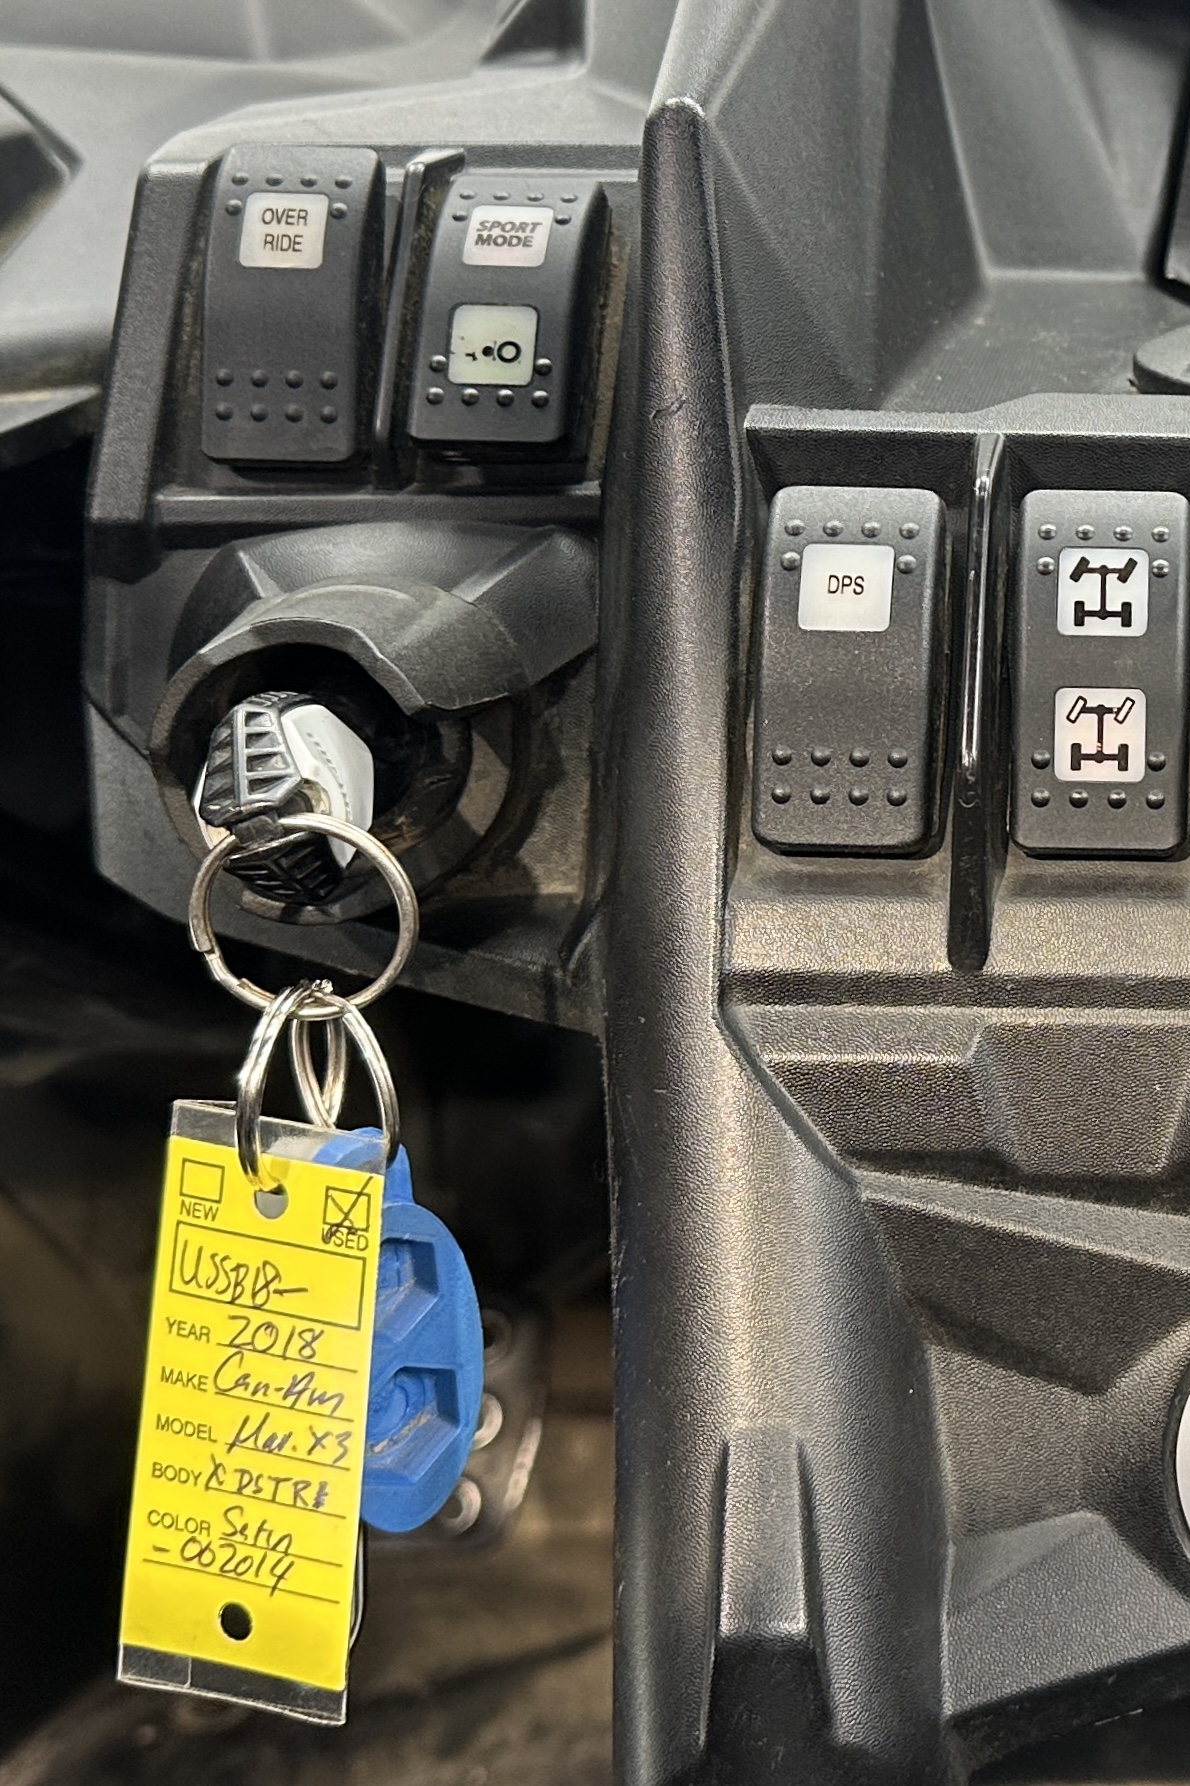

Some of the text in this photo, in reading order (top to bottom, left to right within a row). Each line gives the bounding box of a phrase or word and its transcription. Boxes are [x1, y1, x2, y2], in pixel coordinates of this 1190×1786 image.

[261, 207, 309, 227] OVER
[477, 219, 543, 234] SPORT
[262, 232, 304, 253] RIDE
[474, 232, 534, 249] MODE
[827, 574, 865, 596] DPS
[179, 1198, 220, 1223] NEW
[321, 1226, 370, 1252] USED
[165, 1316, 211, 1344] YEAR
[228, 1314, 325, 1360] 2018
[160, 1365, 209, 1393] MAKE
[155, 1413, 218, 1443] MODEL
[151, 1461, 202, 1487] BODY
[147, 1509, 212, 1538] COLOR
